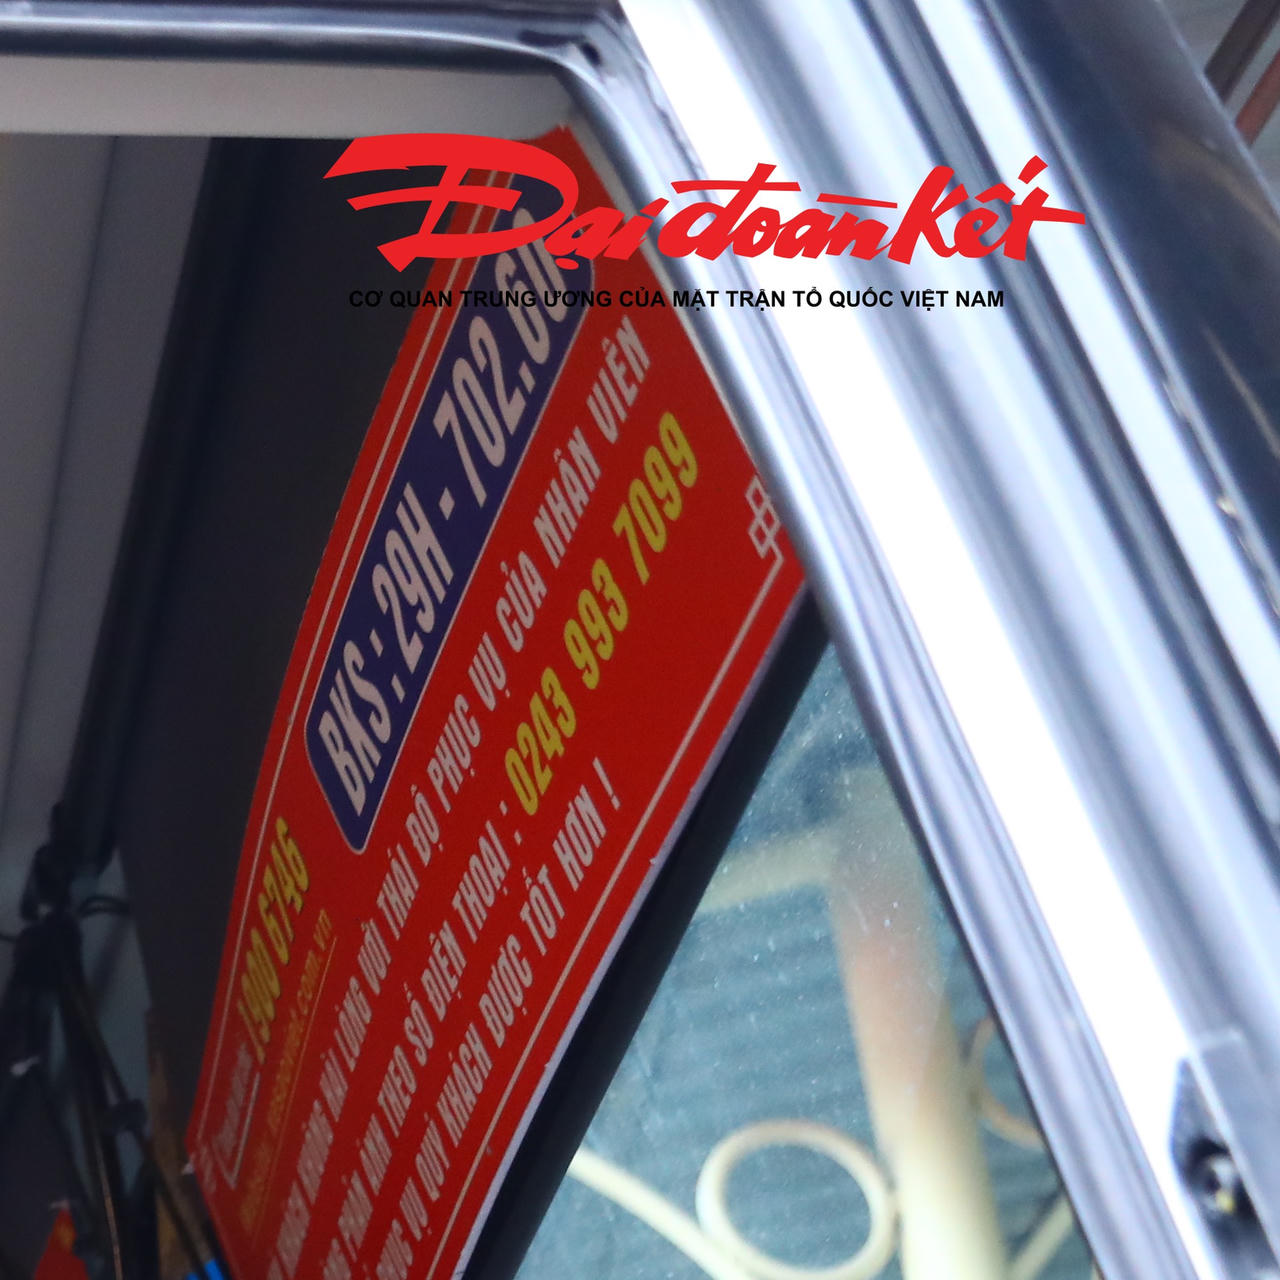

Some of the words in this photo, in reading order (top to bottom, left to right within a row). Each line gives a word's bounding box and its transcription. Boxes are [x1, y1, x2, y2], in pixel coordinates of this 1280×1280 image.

[372, 481, 454, 675] 29H
[334, 974, 373, 1073] LÒNG
[357, 917, 392, 996] VỚI
[376, 843, 420, 941] THÁI
[405, 783, 444, 867] ĐỘ
[426, 694, 481, 814] PHỤC
[467, 631, 510, 712] VỤ
[495, 550, 548, 653] CỦA
[532, 426, 602, 569] NHÂN
[586, 314, 651, 445] VIÊN
[377, 1044, 417, 1139] THEO
[402, 981, 435, 1067] SỐ
[420, 919, 467, 1022] ĐIỆN
[451, 820, 511, 944] THOẠI
[504, 666, 577, 816] 0243
[563, 557, 629, 690] 993
[612, 411, 698, 586] 7099
[257, 815, 310, 967] 6746
[552, 784, 607, 893] HƠN
[519, 863, 566, 957] TỐT
[478, 933, 534, 1049] ĐƯỢC
[436, 1022, 493, 1149] KHÁCH
[399, 1176, 433, 1242] VỤ
[415, 1111, 450, 1203] QUÝ
